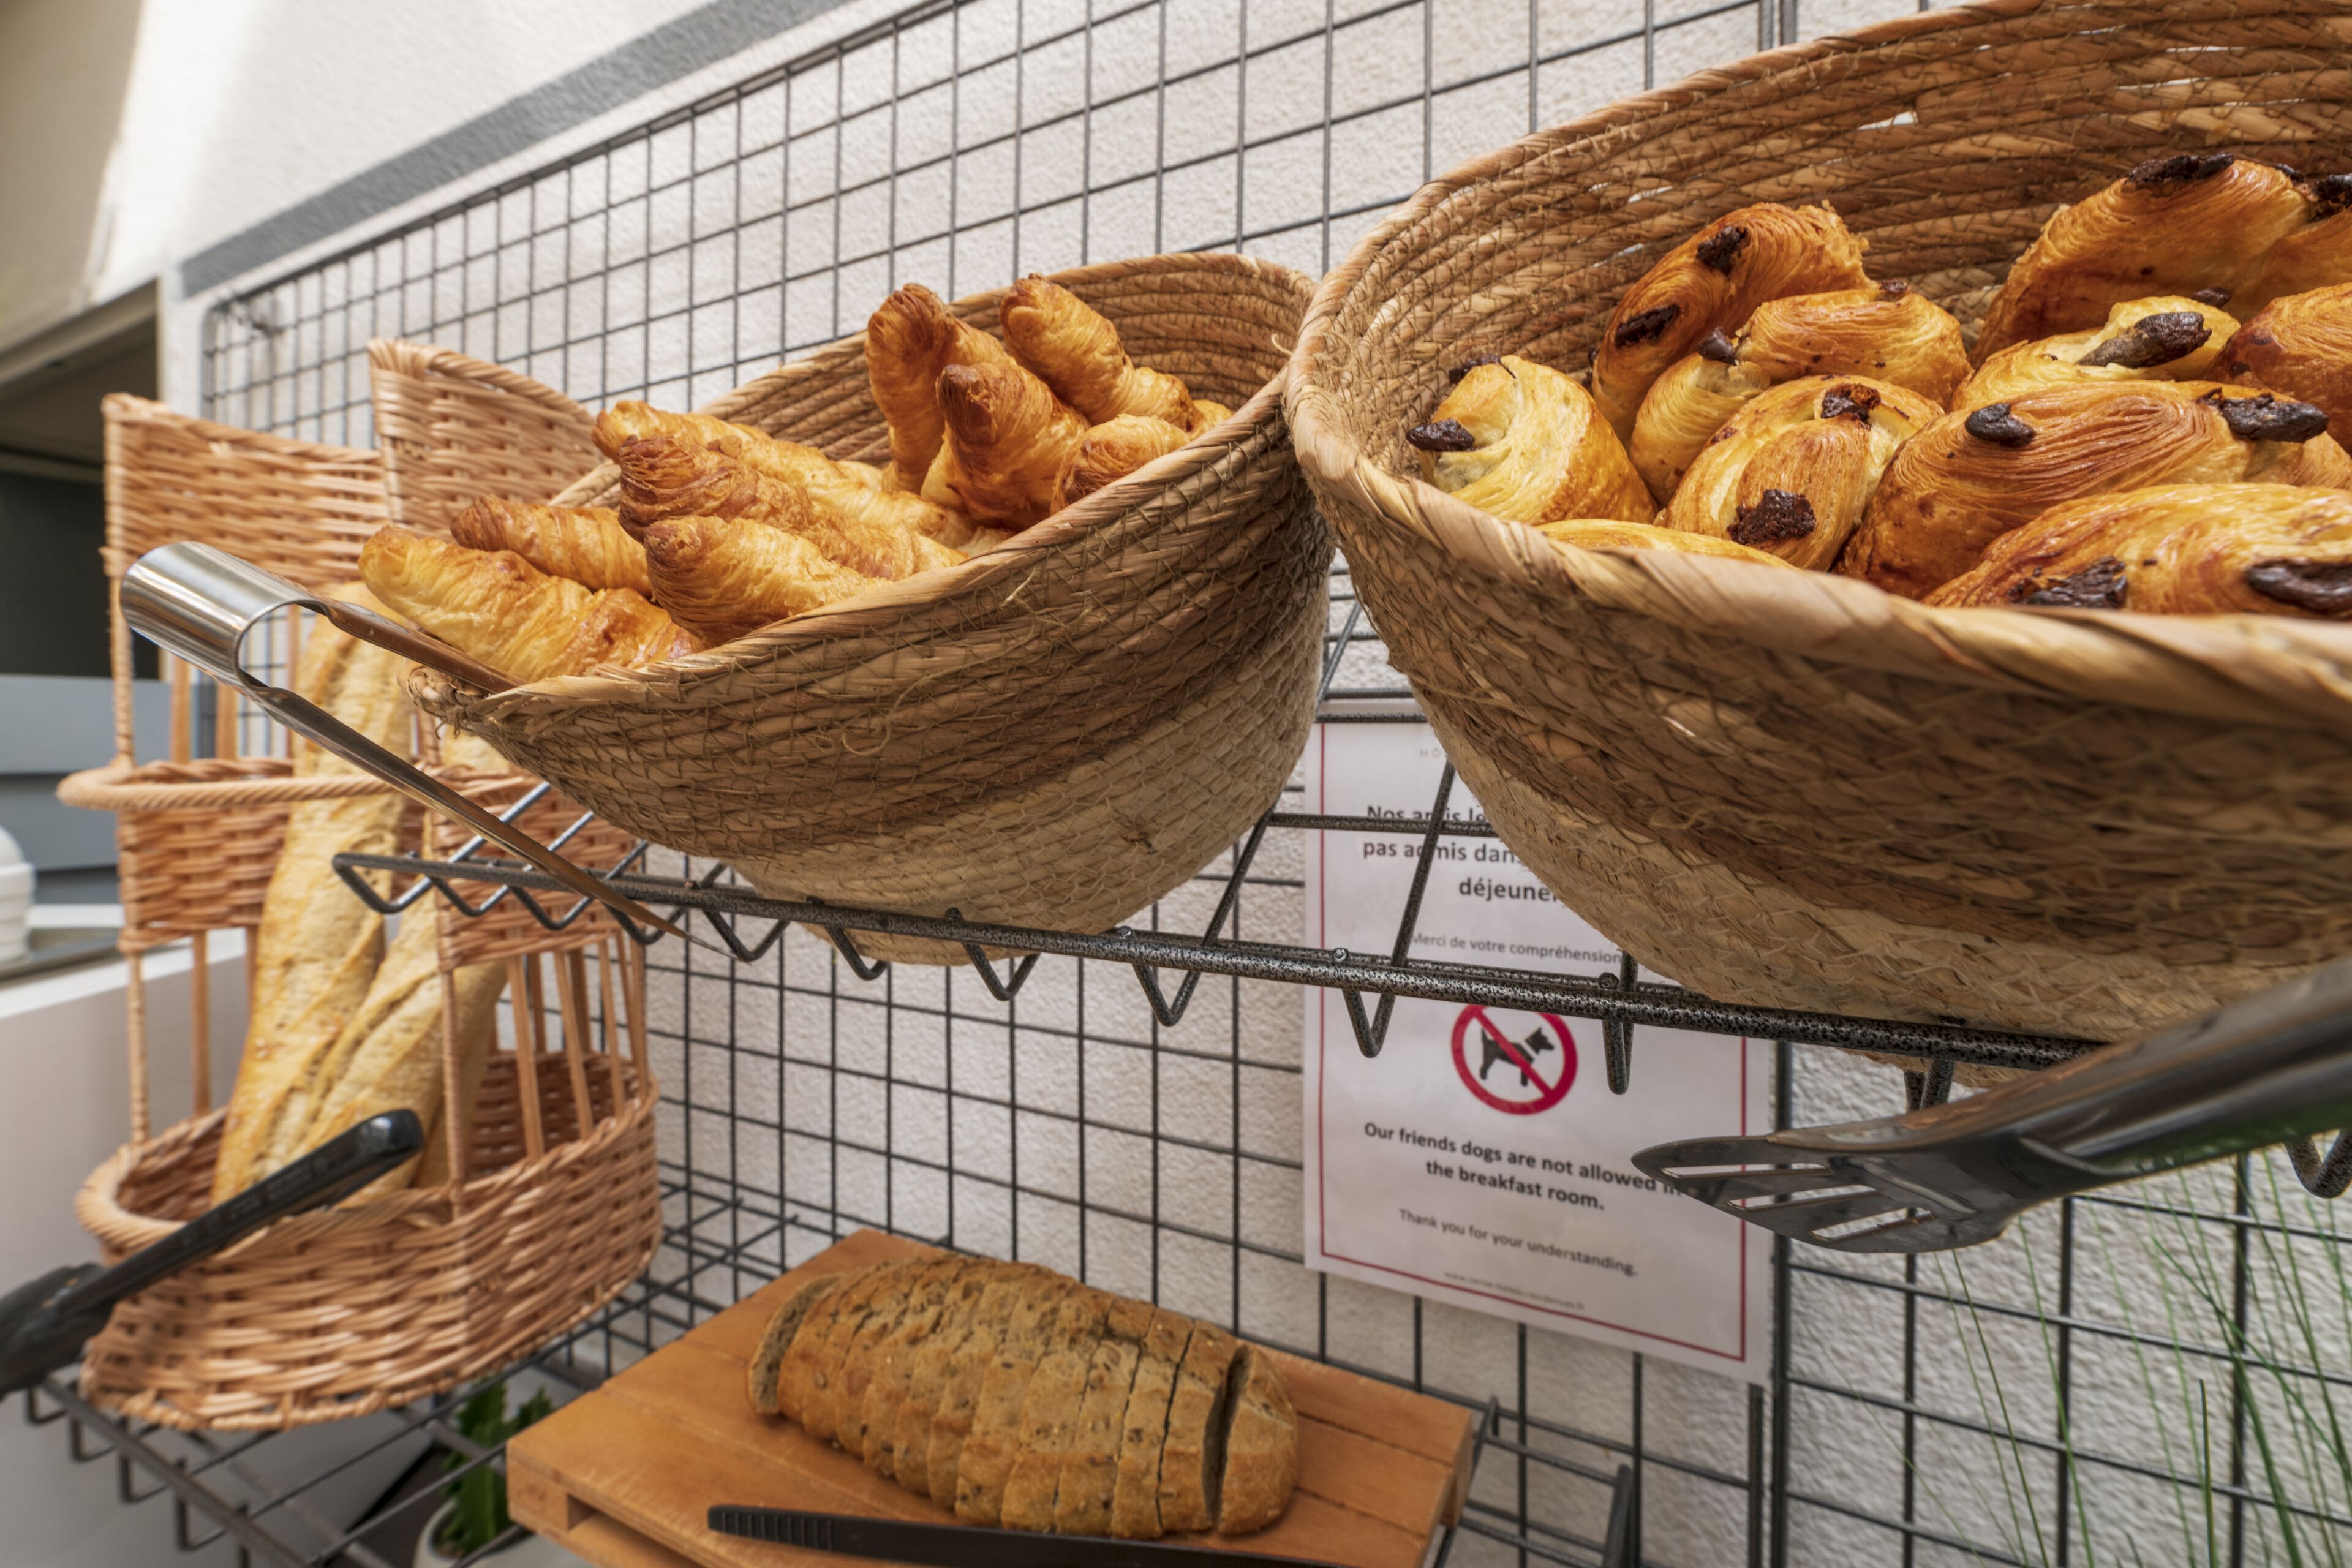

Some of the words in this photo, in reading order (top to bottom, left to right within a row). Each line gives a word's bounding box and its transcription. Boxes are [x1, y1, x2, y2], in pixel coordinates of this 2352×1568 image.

[1363, 842, 1397, 859] pas
[1474, 843, 1521, 864] dan
[1411, 933, 1446, 947] Merci
[1450, 935, 1466, 949] de
[1470, 939, 1506, 954] votre
[1510, 943, 1622, 964] compréhension
[1365, 1123, 1394, 1139] Our
[1400, 1128, 1456, 1153] friends
[1461, 1140, 1502, 1163] dogs
[1507, 1152, 1536, 1168] are
[1542, 1158, 1572, 1175] not
[1578, 1163, 1656, 1192] allowed
[1426, 1161, 1453, 1179] the
[1459, 1166, 1542, 1197] breakfast
[1548, 1187, 1604, 1210] room.
[1400, 1208, 1438, 1229] Thank
[1441, 1220, 1465, 1235] you
[1469, 1226, 1487, 1240] for
[1491, 1233, 1524, 1248] your
[1528, 1241, 1638, 1278] understanding.
